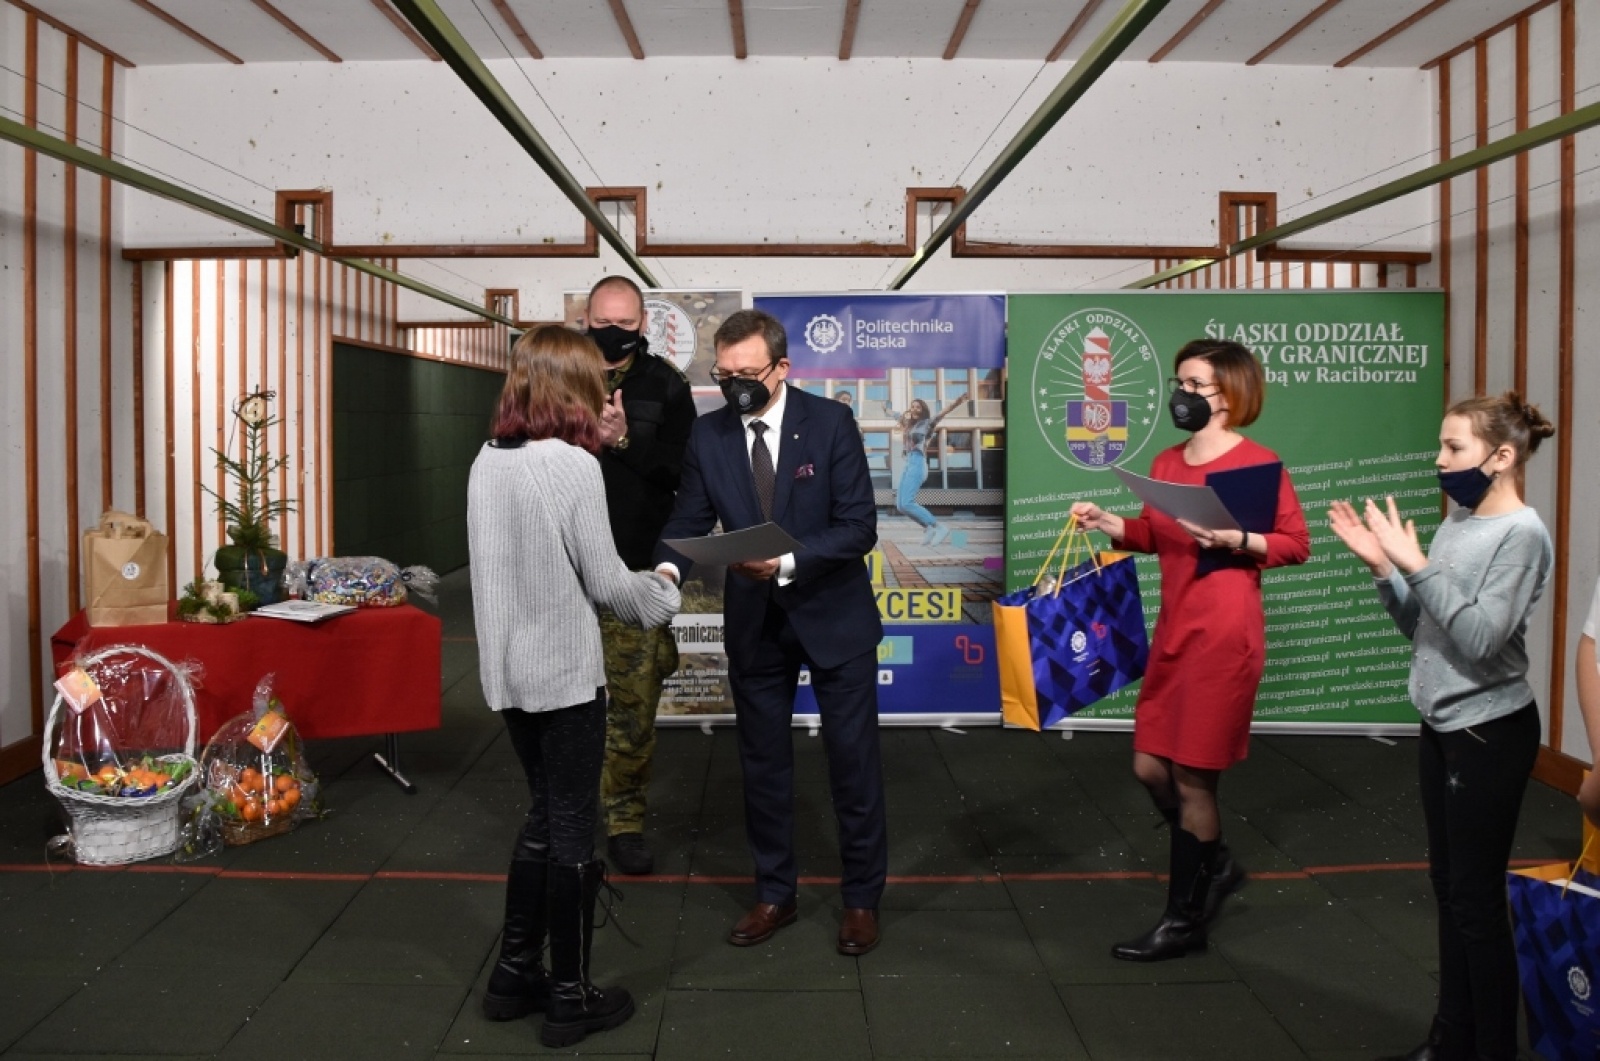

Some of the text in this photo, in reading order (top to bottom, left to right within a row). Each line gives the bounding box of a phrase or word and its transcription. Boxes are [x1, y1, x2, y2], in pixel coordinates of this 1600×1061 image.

[855, 319, 954, 334] Politechnika
[1204, 319, 1404, 345] ŚLĄSKI ODDZIAŁ
[855, 333, 907, 350] Śląska
[1280, 345, 1428, 367] GRANICZNEJ
[1294, 369, 1309, 383] w
[1316, 366, 1417, 383] Raciborzu
